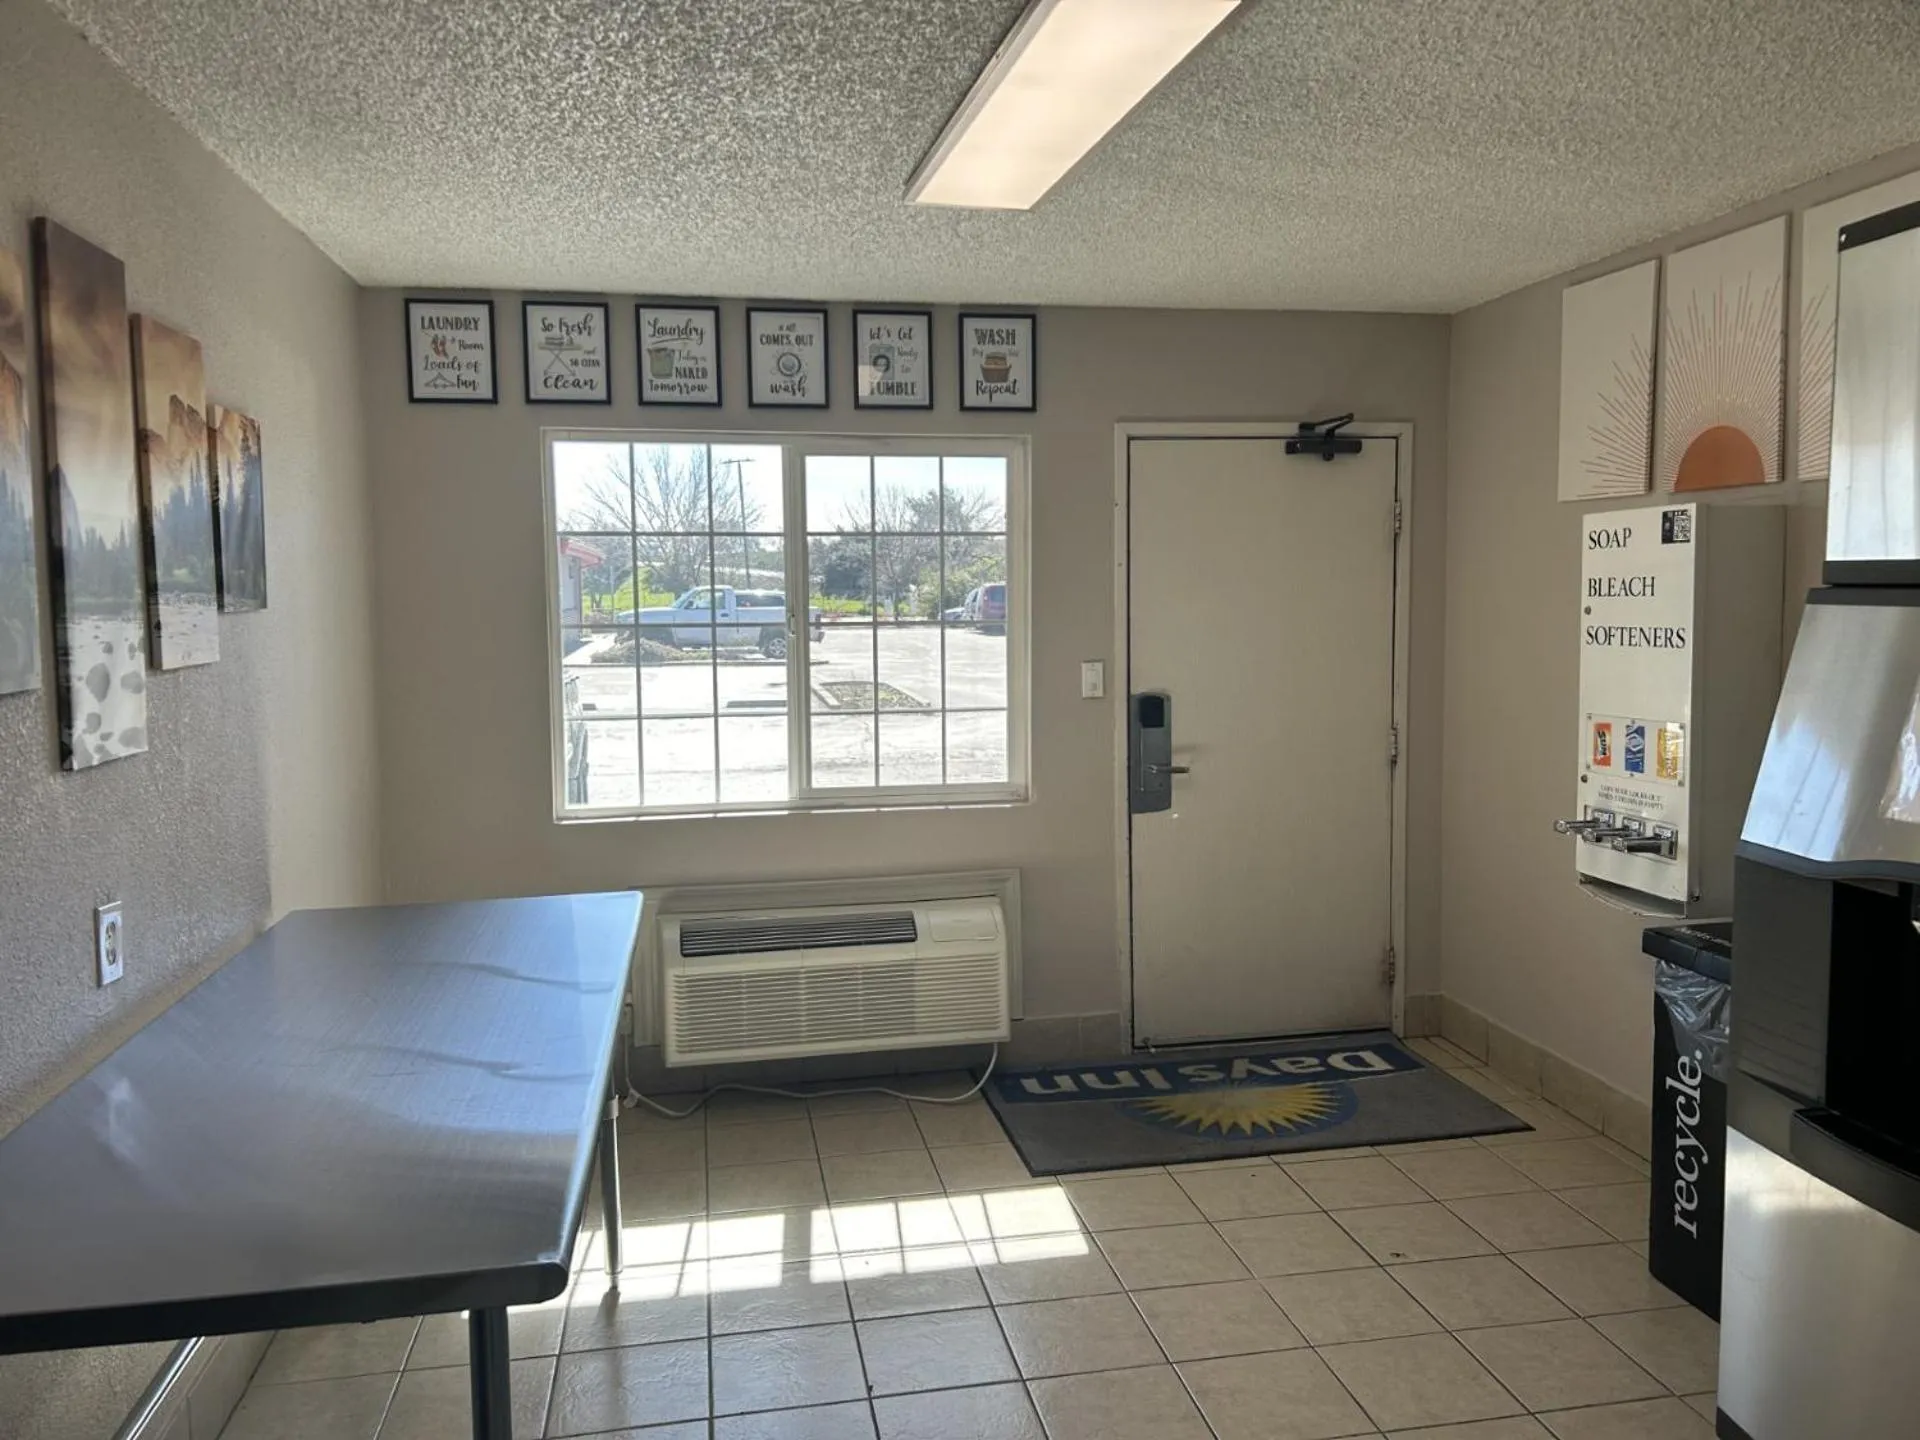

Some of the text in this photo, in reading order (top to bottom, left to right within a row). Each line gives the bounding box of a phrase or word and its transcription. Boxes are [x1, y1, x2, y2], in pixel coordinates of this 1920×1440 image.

[420, 315, 481, 331] LAUNDRY
[541, 312, 596, 336] So Fresh
[647, 317, 705, 346] Laundry
[759, 333, 815, 347] COMES OUT
[973, 327, 1016, 345] WASH
[675, 366, 708, 379] NAKED
[648, 379, 709, 395] Tomorrow
[869, 381, 916, 397] TUMBLE
[975, 378, 1019, 403] Repeat
[1588, 527, 1632, 550] SOAP
[1588, 576, 1656, 598] BLEACH
[1586, 625, 1686, 649] SOFTENERS
[1019, 1048, 1396, 1096] Days Inn
